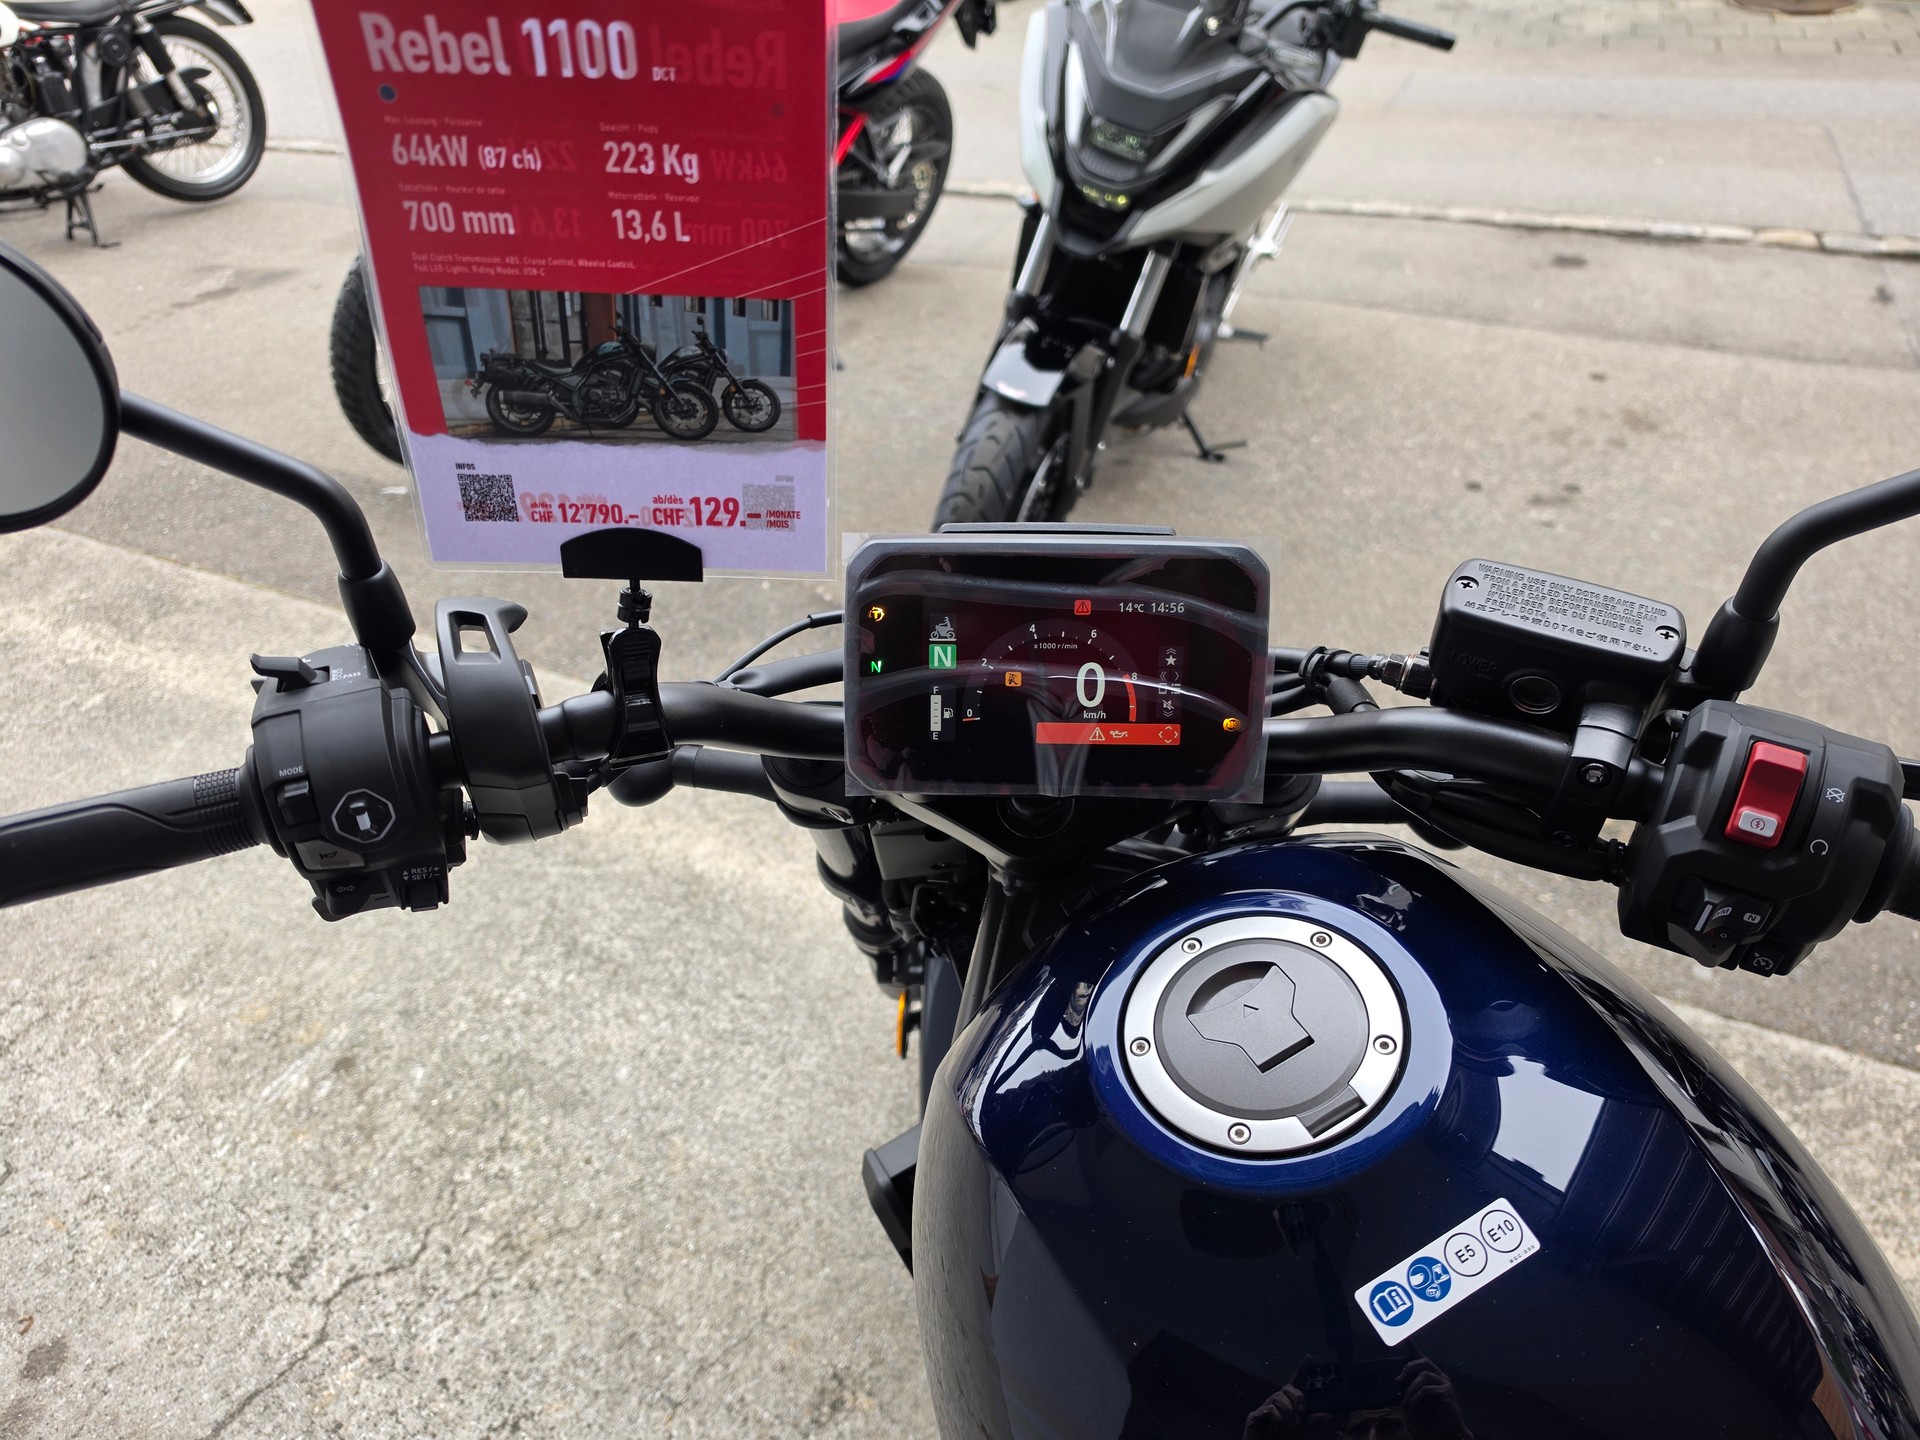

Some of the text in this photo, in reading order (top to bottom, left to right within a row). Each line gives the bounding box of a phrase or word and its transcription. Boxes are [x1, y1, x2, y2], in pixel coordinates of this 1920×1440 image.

[359, 12, 638, 80] Rebel 1100
[652, 67, 676, 82] DCT
[599, 122, 630, 132] Gewicht
[392, 133, 541, 171] 64kW (87 ch)
[603, 141, 700, 184] 223 Kg
[608, 191, 657, 201] Motorradtank
[402, 201, 515, 236] 700 mm
[611, 208, 690, 244] 13,6 L
[652, 495, 684, 505] ab/dès
[531, 511, 553, 522] CHF
[652, 508, 685, 526] CHF
[766, 510, 801, 520] /MONATE
[766, 520, 789, 528] /MOIS
[1478, 563, 1667, 617] WARNING USE ONLY DOT4 BRAKE FLUID
[1483, 573, 1510, 585] FROM
[1511, 580, 1519, 588] A
[1521, 583, 1561, 598] SEALED
[1622, 608, 1658, 622] CLEAN
[1490, 583, 1525, 598] FILLER
[1527, 592, 1547, 601] CAP
[1549, 597, 1588, 613] BEFORE
[1151, 603, 1185, 613] 14:56
[1485, 598, 1516, 611] FREIN
[1548, 605, 1569, 616] QUE
[1571, 611, 1586, 620] DU
[1588, 616, 1626, 631] FLUIDE
[1628, 625, 1643, 635] DE
[1029, 624, 1036, 632] 4
[1091, 630, 1097, 638] 6
[934, 646, 951, 667] N
[981, 658, 988, 666] 2
[871, 661, 882, 673] N
[343, 671, 361, 679] PASS
[1131, 673, 1137, 681] 8
[934, 686, 939, 694] F
[1077, 662, 1105, 707] 0
[967, 709, 973, 717] 0
[1084, 711, 1106, 719] km/h
[933, 732, 939, 740] E
[279, 766, 303, 776] MODE
[1487, 1219, 1514, 1243] E10
[1454, 1244, 1476, 1264] E5
